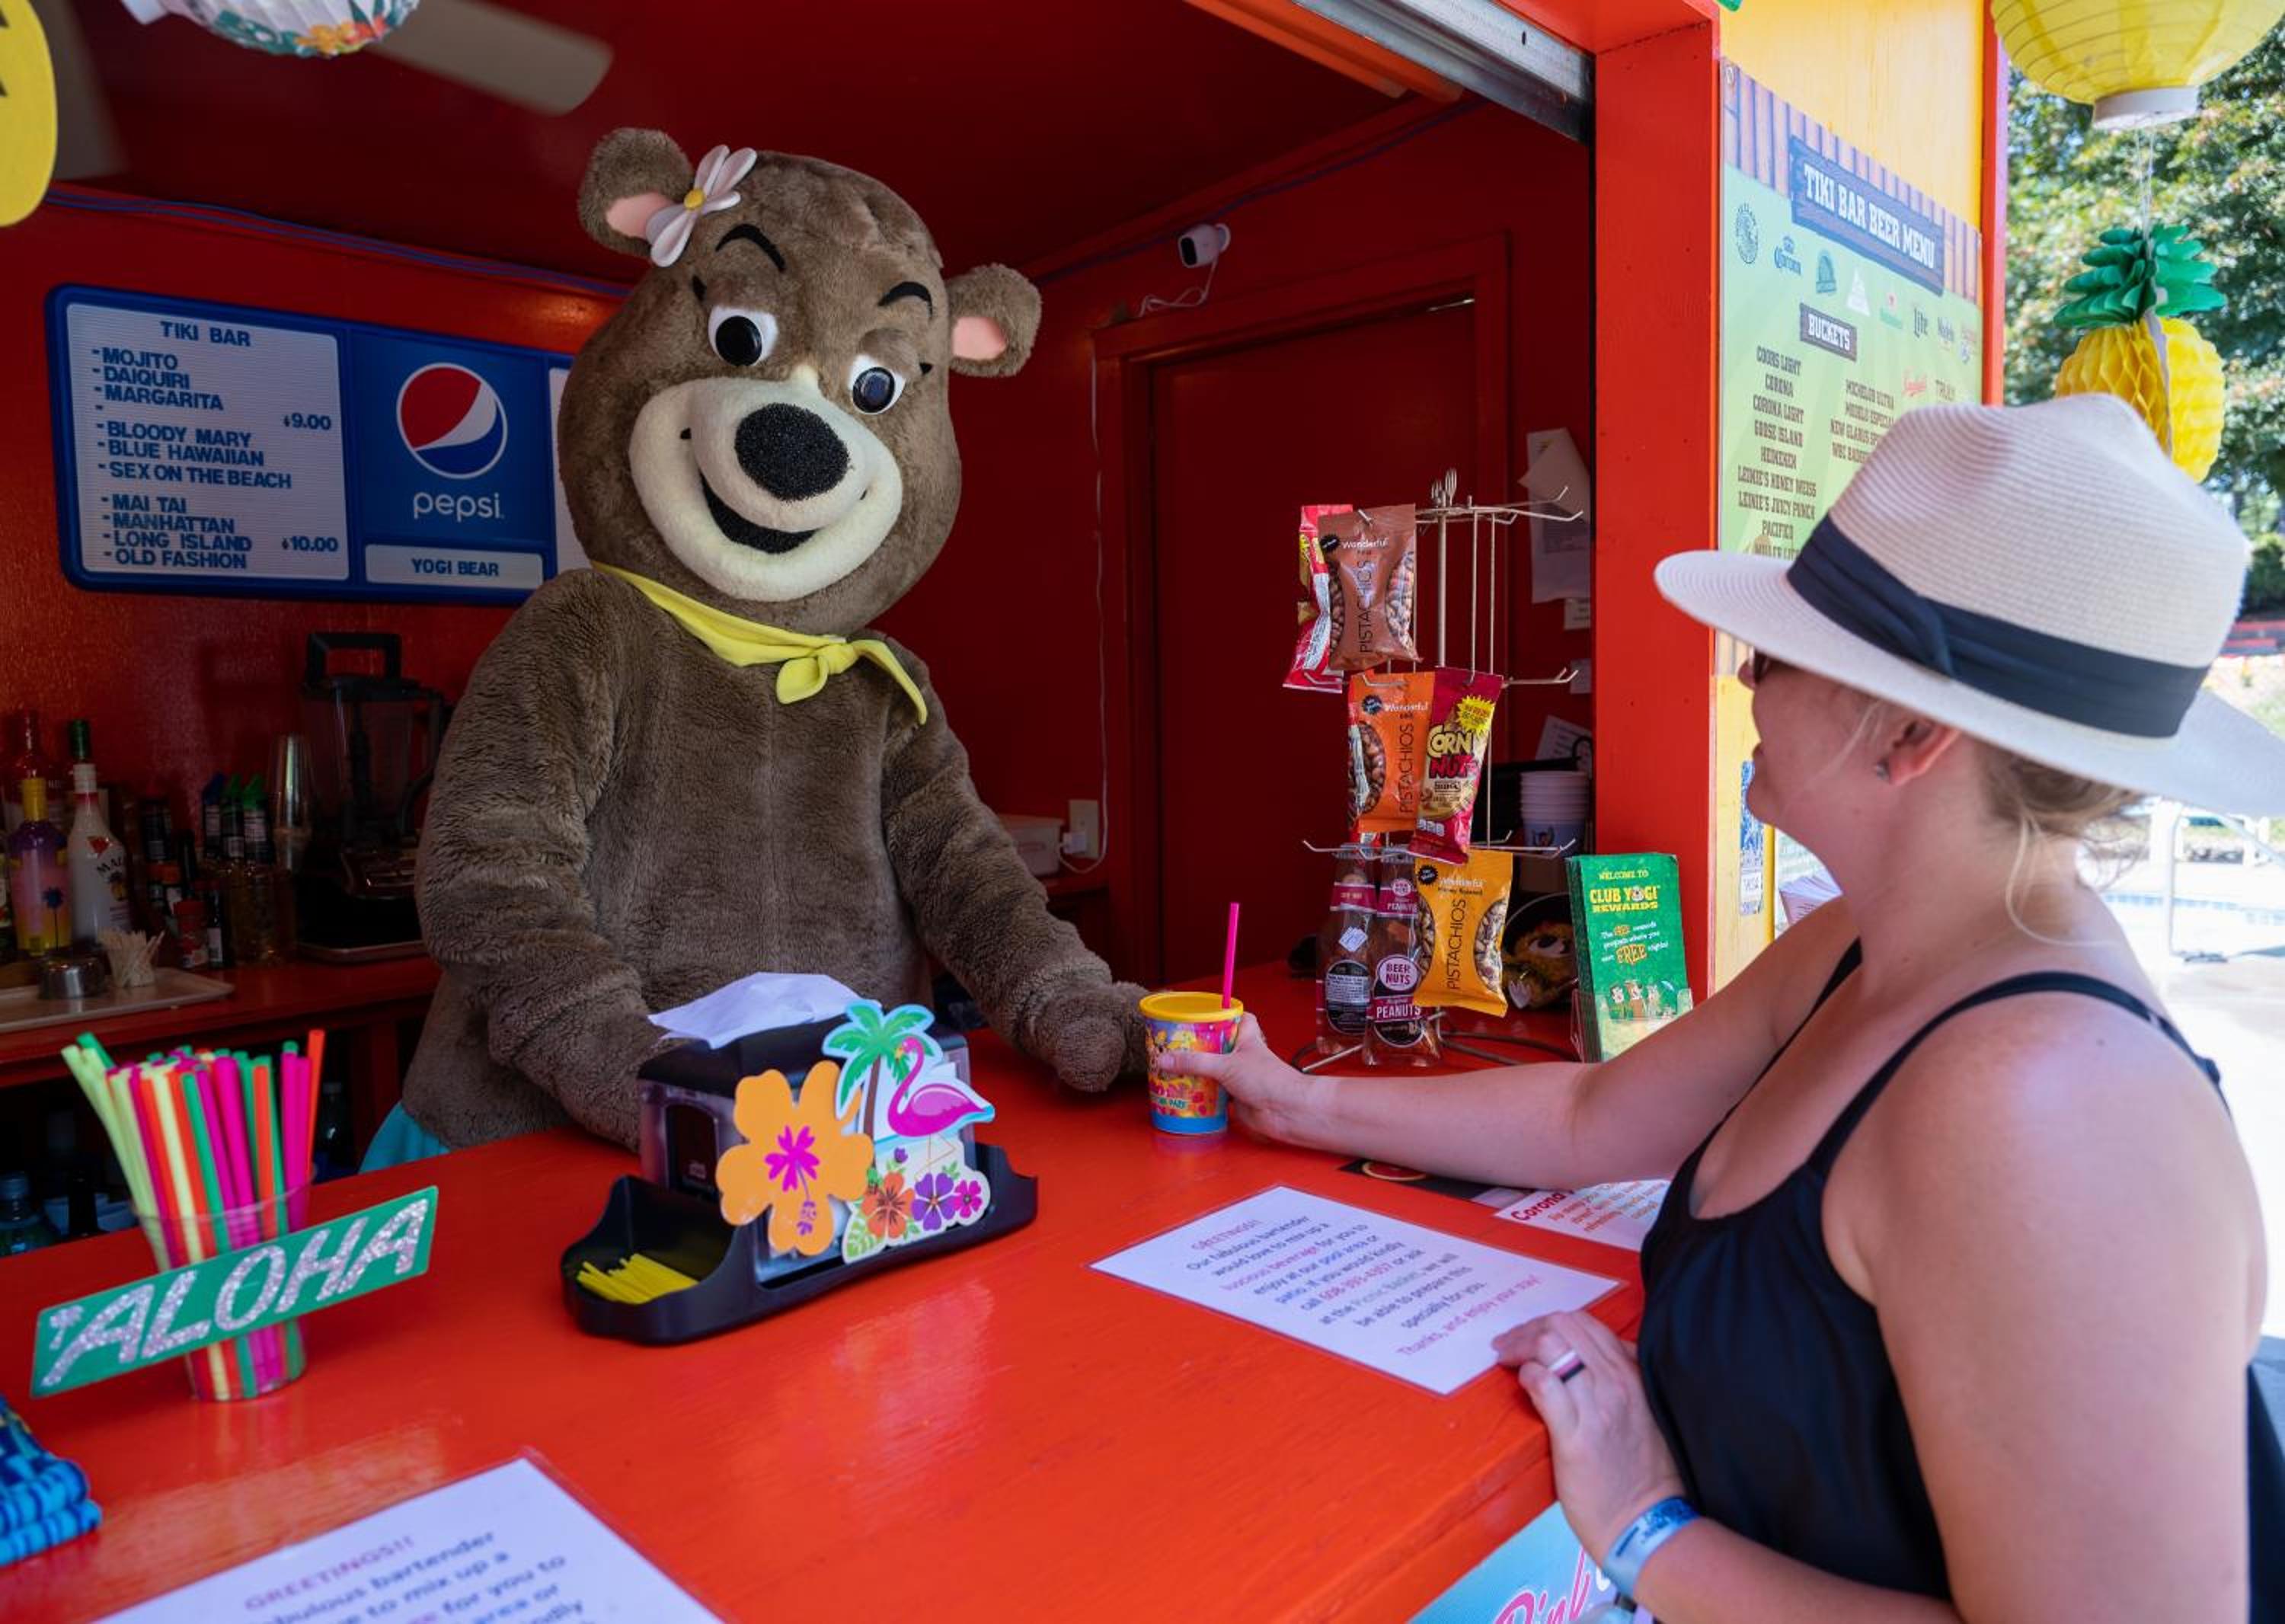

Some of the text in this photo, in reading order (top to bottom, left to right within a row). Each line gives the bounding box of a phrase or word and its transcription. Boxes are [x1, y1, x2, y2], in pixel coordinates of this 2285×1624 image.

[1804, 162, 1935, 269] TIKI BAR BEER MENU
[161, 321, 251, 347] TIKI BAR
[1808, 313, 1850, 351] BUCKETS
[102, 347, 177, 370] MOJITO
[1756, 345, 1801, 376] COORS LIGHT
[104, 366, 190, 390] DAIQUIRI
[1766, 373, 1794, 398] CORONA
[105, 384, 225, 411] MARGARITA
[1753, 395, 1804, 424] CORONA LIGHT
[107, 420, 252, 448] BLOODY MARY
[1754, 420, 1803, 448] GOOSE ISLAND
[108, 439, 264, 467] BLUE HAWAIIAN
[1761, 446, 1797, 469] HEINEKEN
[110, 462, 292, 489] SEX ON THE BEACH
[112, 494, 187, 513] MAI TAI
[413, 491, 501, 523] pepsi
[113, 513, 235, 534] MANHATTAN
[1762, 520, 1794, 539] PACIFICO
[114, 530, 253, 552] LONG ISLAND
[115, 548, 248, 570] OLD FASHION
[412, 558, 499, 577] YOGI BEAR
[1427, 724, 1473, 757] CORN
[1399, 724, 1414, 813] PISTACHIOS
[1599, 869, 1649, 880] WELCOME TO
[1590, 888, 1621, 903] CLUB
[1593, 901, 1657, 913] REWARDS
[1448, 899, 1466, 990] PISTACHIOS
[1616, 945, 1647, 964] FREE
[1385, 974, 1411, 985] NUTS
[1386, 964, 1410, 973] BEER
[1376, 1005, 1421, 1018] PEANUTS
[1511, 1192, 1567, 1220] Corona
[1186, 1216, 1309, 1270] Our fabulous bartender
[1245, 1248, 1274, 1260] love
[1269, 1241, 1286, 1249] to
[41, 1197, 429, 1387] ALOHA
[244, 1536, 414, 1610] GREETINGS!!
[370, 1533, 492, 1588] bartender
